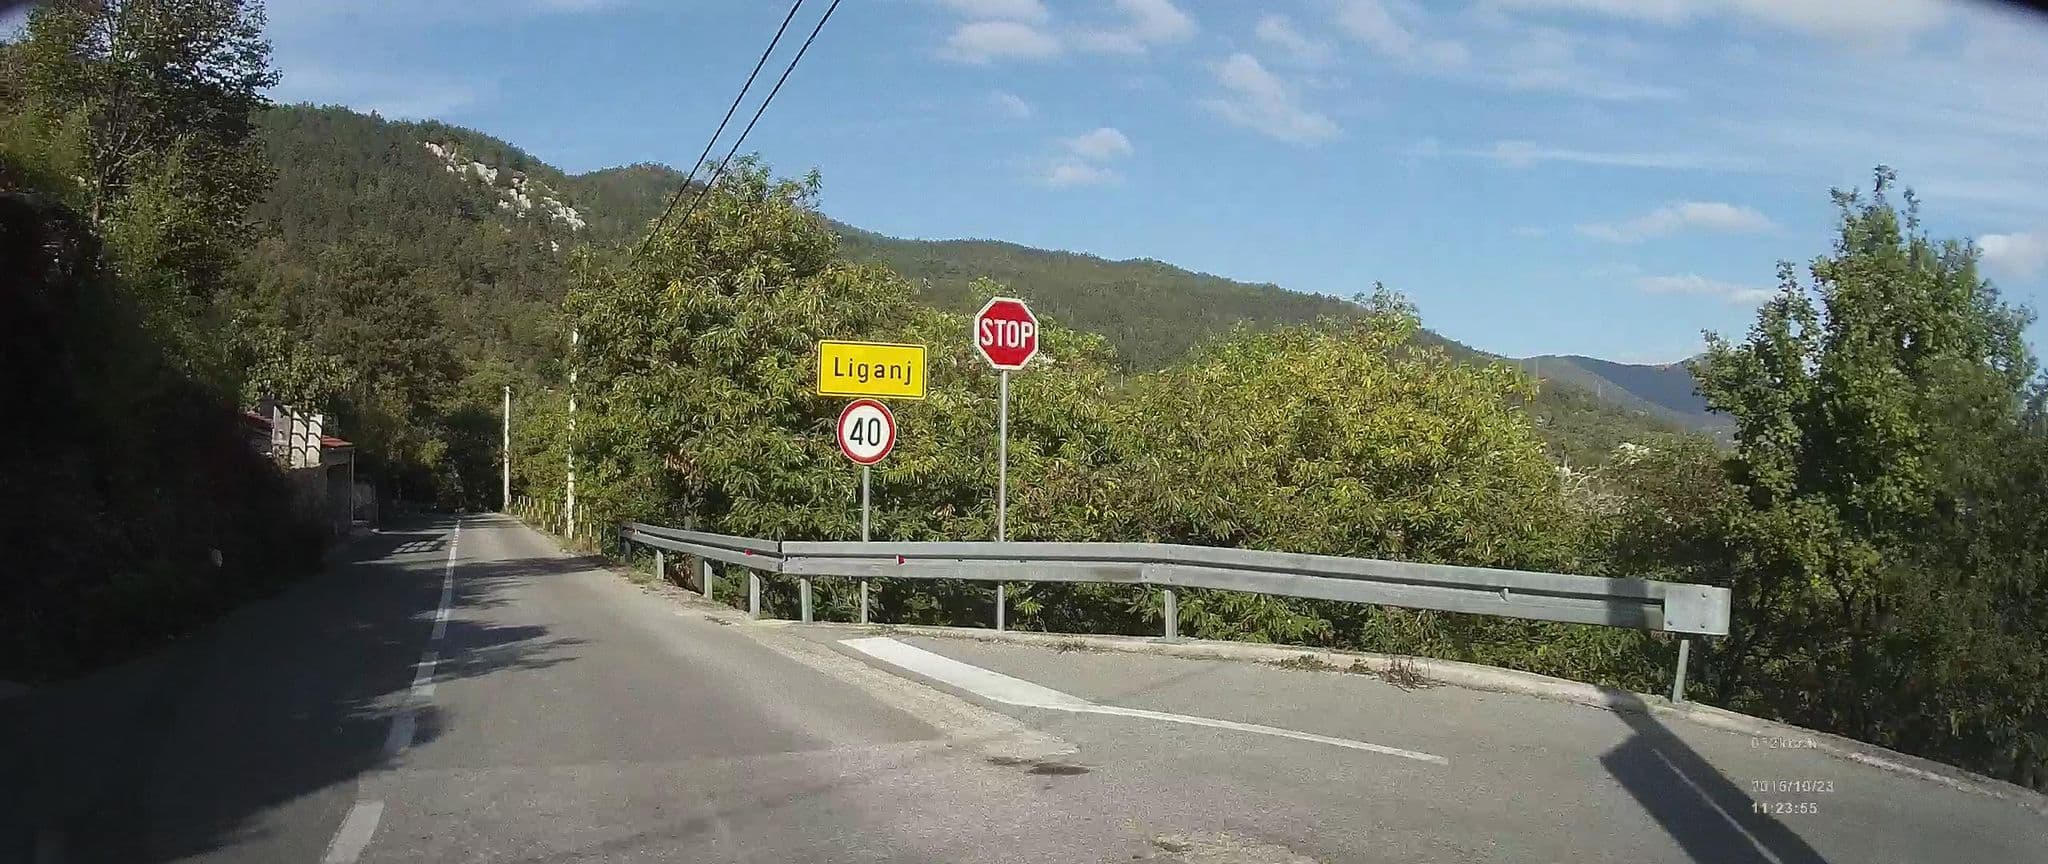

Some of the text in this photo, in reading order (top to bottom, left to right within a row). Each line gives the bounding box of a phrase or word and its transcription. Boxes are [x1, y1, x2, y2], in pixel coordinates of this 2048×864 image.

[981, 318, 1034, 348] STOP
[834, 357, 912, 385] Liganj
[850, 417, 881, 446] 40
